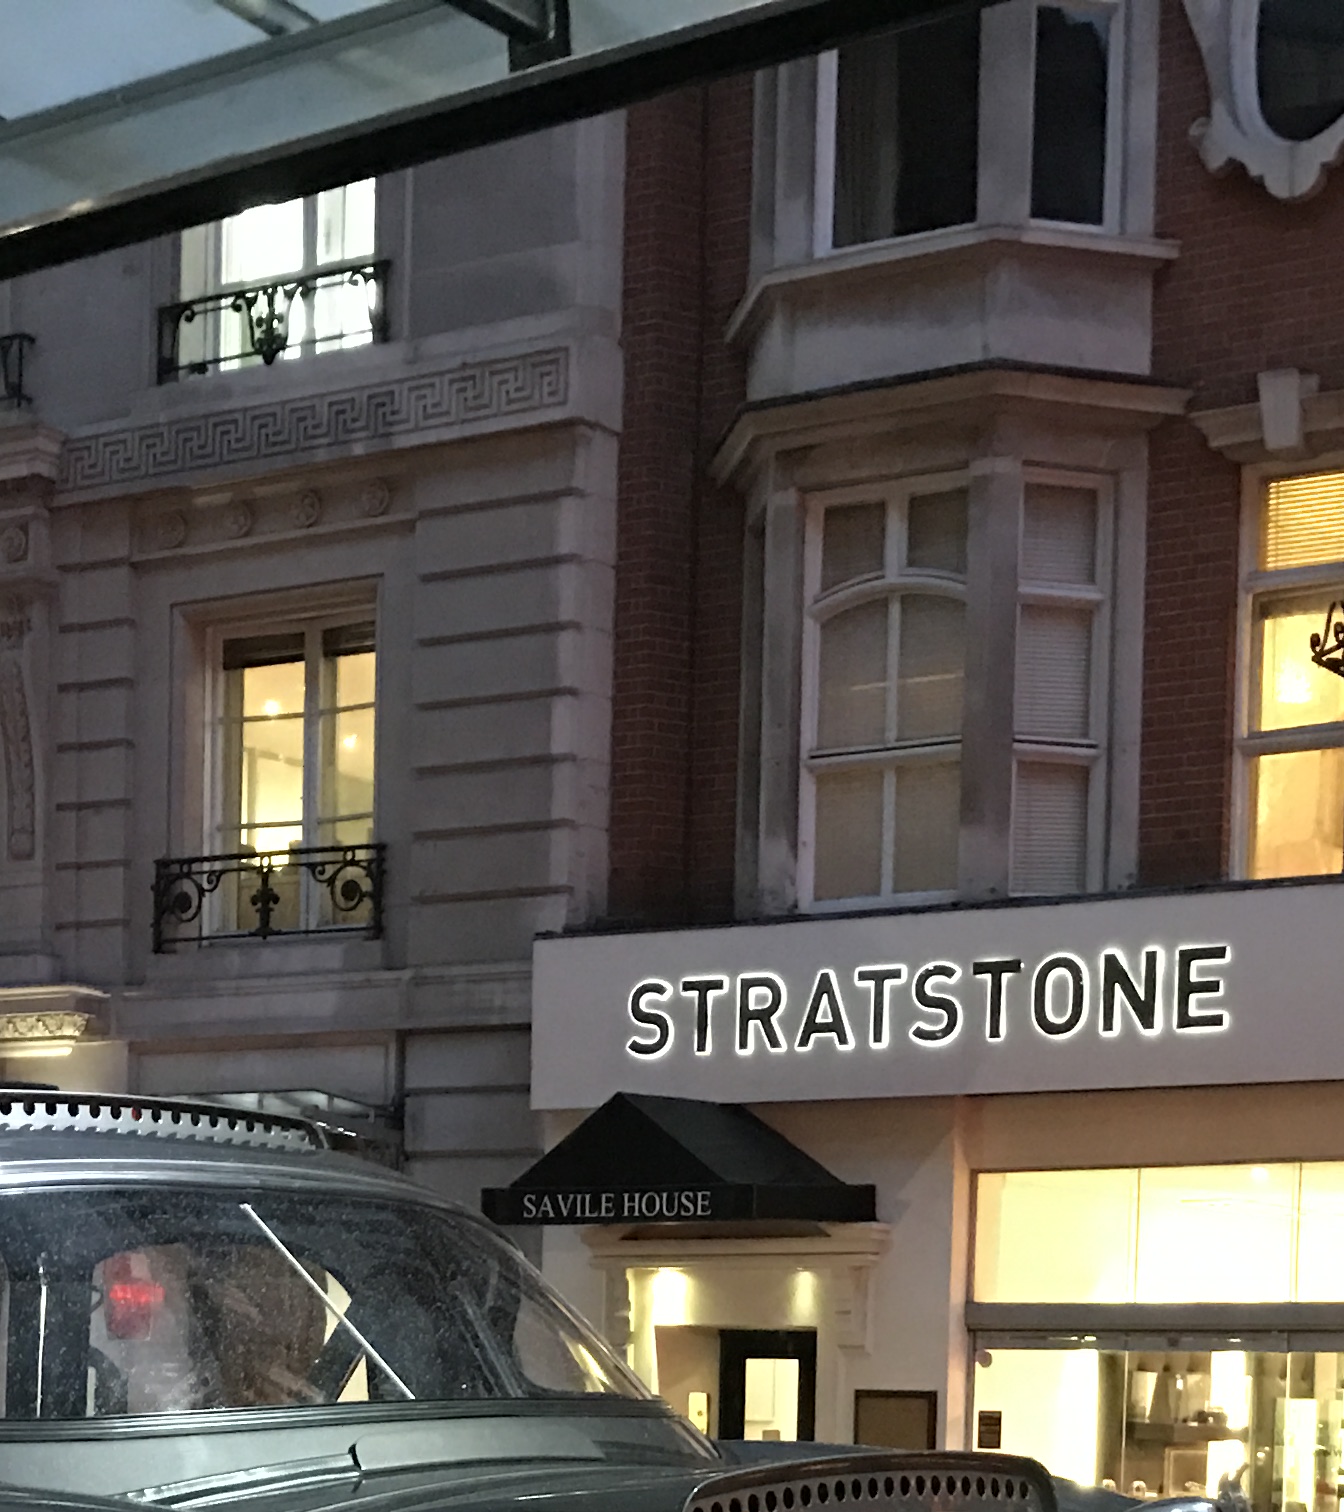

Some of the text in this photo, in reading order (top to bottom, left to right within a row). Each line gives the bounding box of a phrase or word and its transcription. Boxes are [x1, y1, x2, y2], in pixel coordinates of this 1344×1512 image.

[625, 944, 1231, 1058] STRATSTONE
[522, 1190, 712, 1218] SAVILE HOUSE
